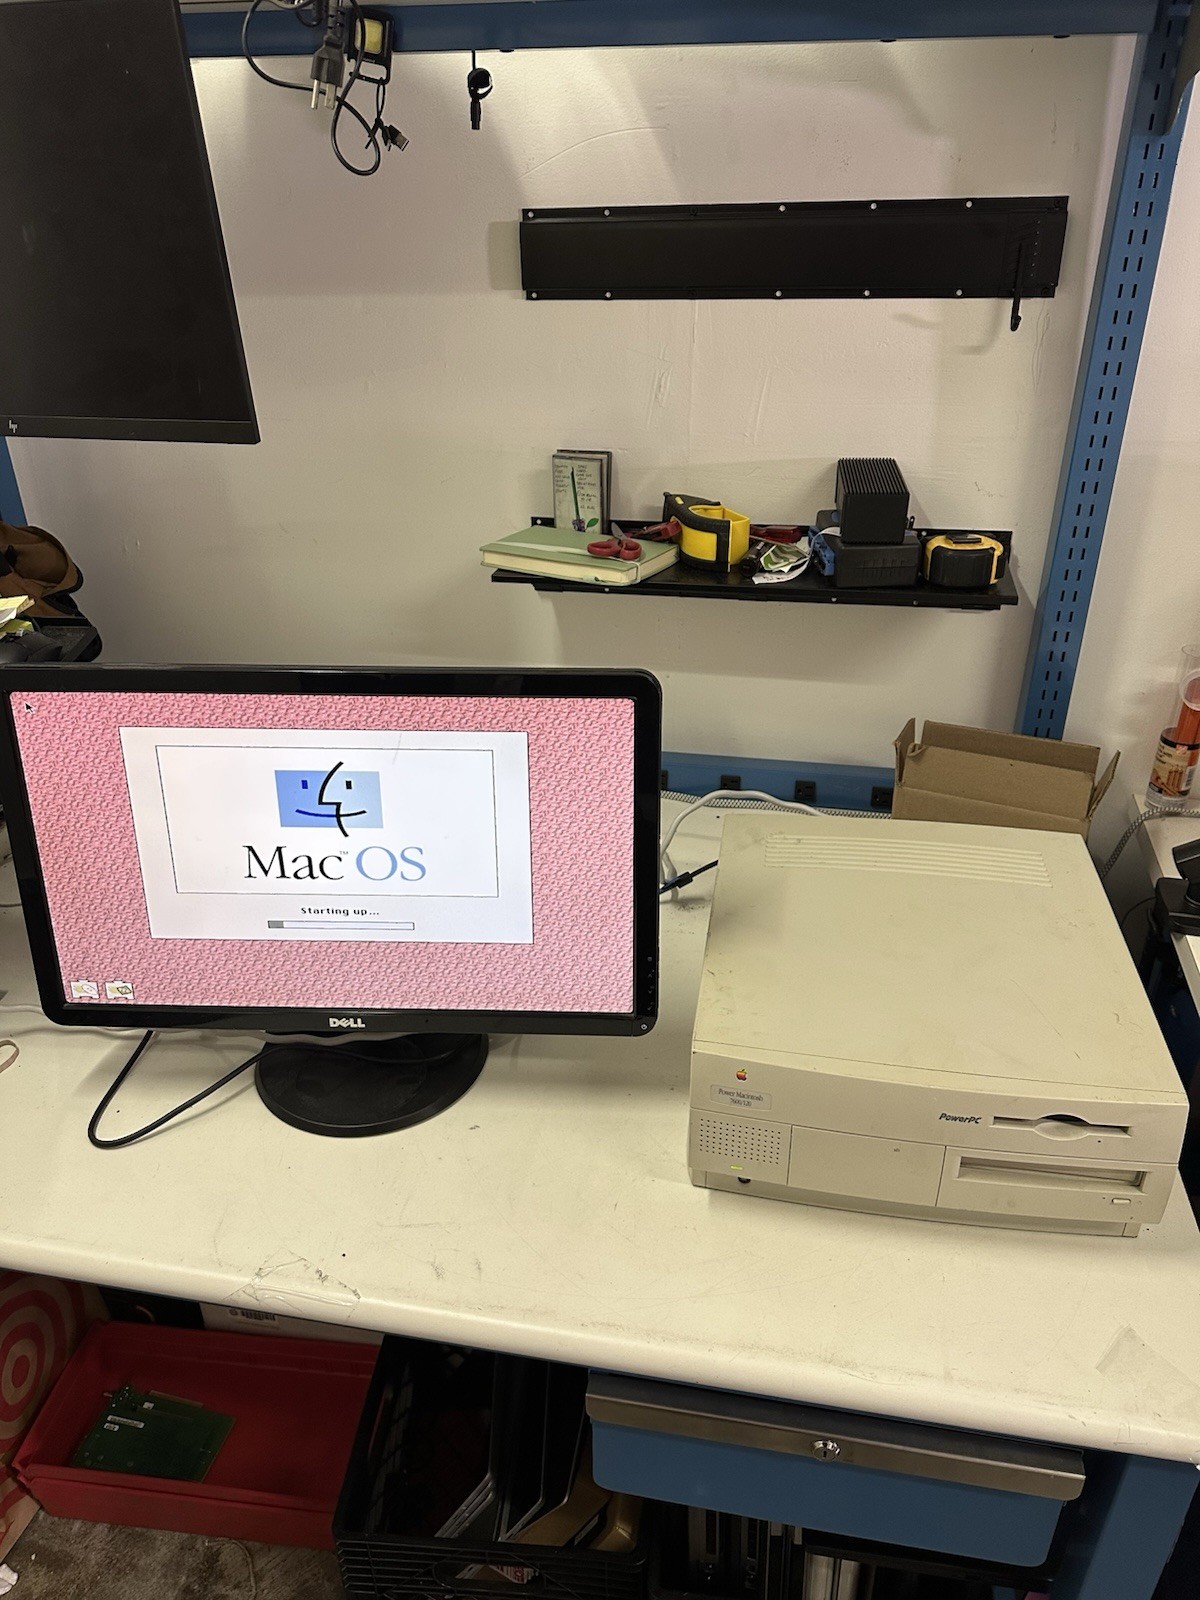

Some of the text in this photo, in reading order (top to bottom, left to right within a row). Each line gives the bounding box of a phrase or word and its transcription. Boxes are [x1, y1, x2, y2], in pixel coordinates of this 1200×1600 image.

[242, 845, 345, 881] Mac
[355, 846, 427, 882] OS
[300, 906, 380, 917] Starting up...
[328, 1017, 366, 1028] DELL
[718, 1088, 764, 1102] Power Macintosh
[938, 1112, 982, 1125] PowerPC
